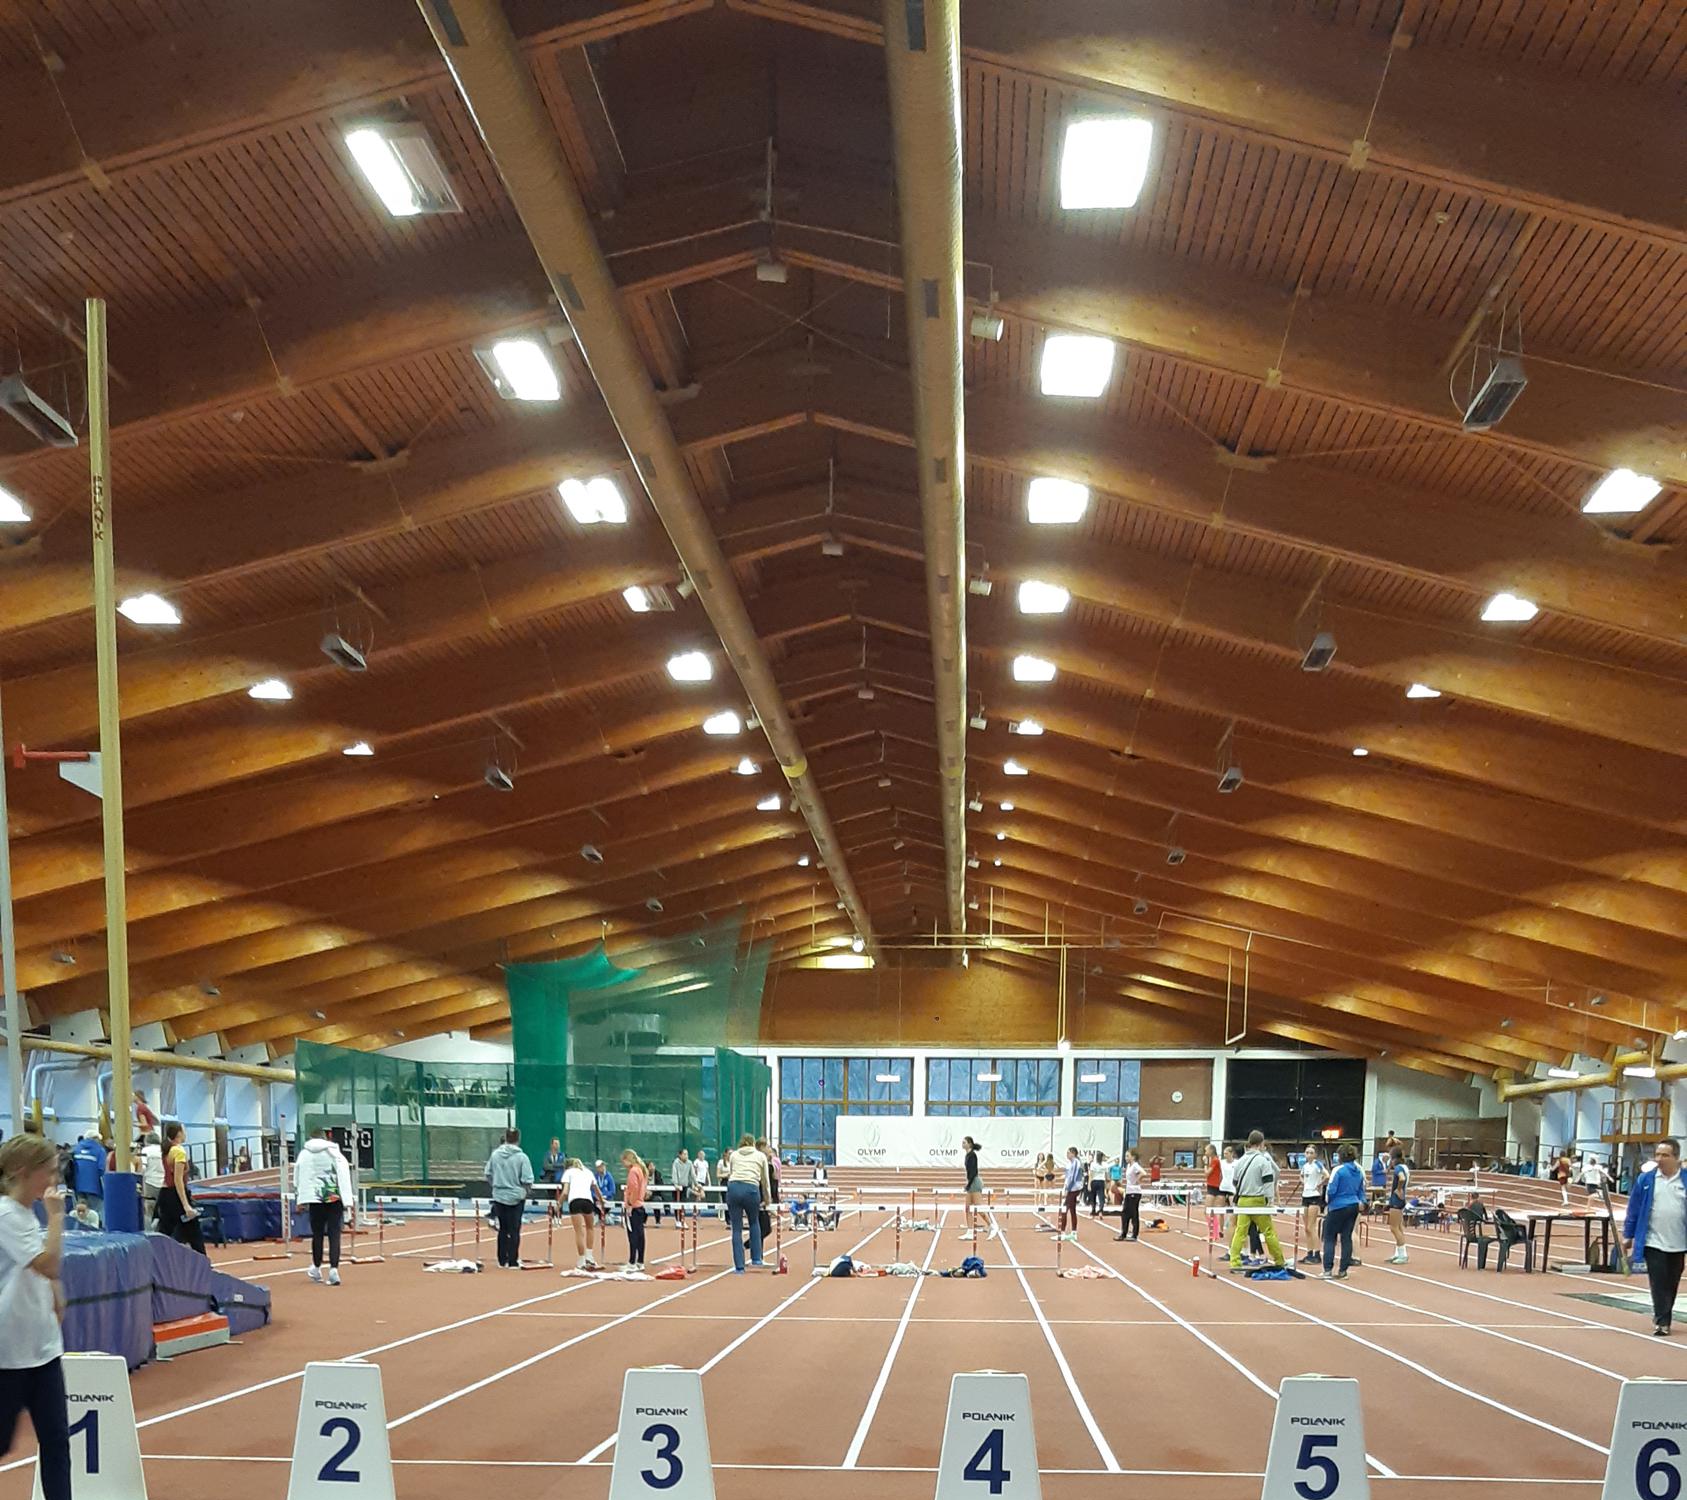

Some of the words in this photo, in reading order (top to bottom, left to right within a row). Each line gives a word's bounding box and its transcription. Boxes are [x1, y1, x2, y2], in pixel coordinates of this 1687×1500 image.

[857, 1148, 887, 1157] OLYMP
[929, 1148, 958, 1157] OLYMP
[1000, 1149, 1030, 1158] OLYMP
[315, 1400, 368, 1411] POLANIK
[635, 1407, 689, 1417] POLANIK
[962, 1412, 1016, 1422] POLANIK
[1290, 1417, 1346, 1427] POLANIK
[1631, 1421, 1687, 1430] POLANIK
[69, 1409, 99, 1474] 1
[317, 1417, 361, 1483] 2
[640, 1423, 684, 1489] 3
[963, 1428, 1011, 1495] 4
[1293, 1434, 1340, 1500] 5
